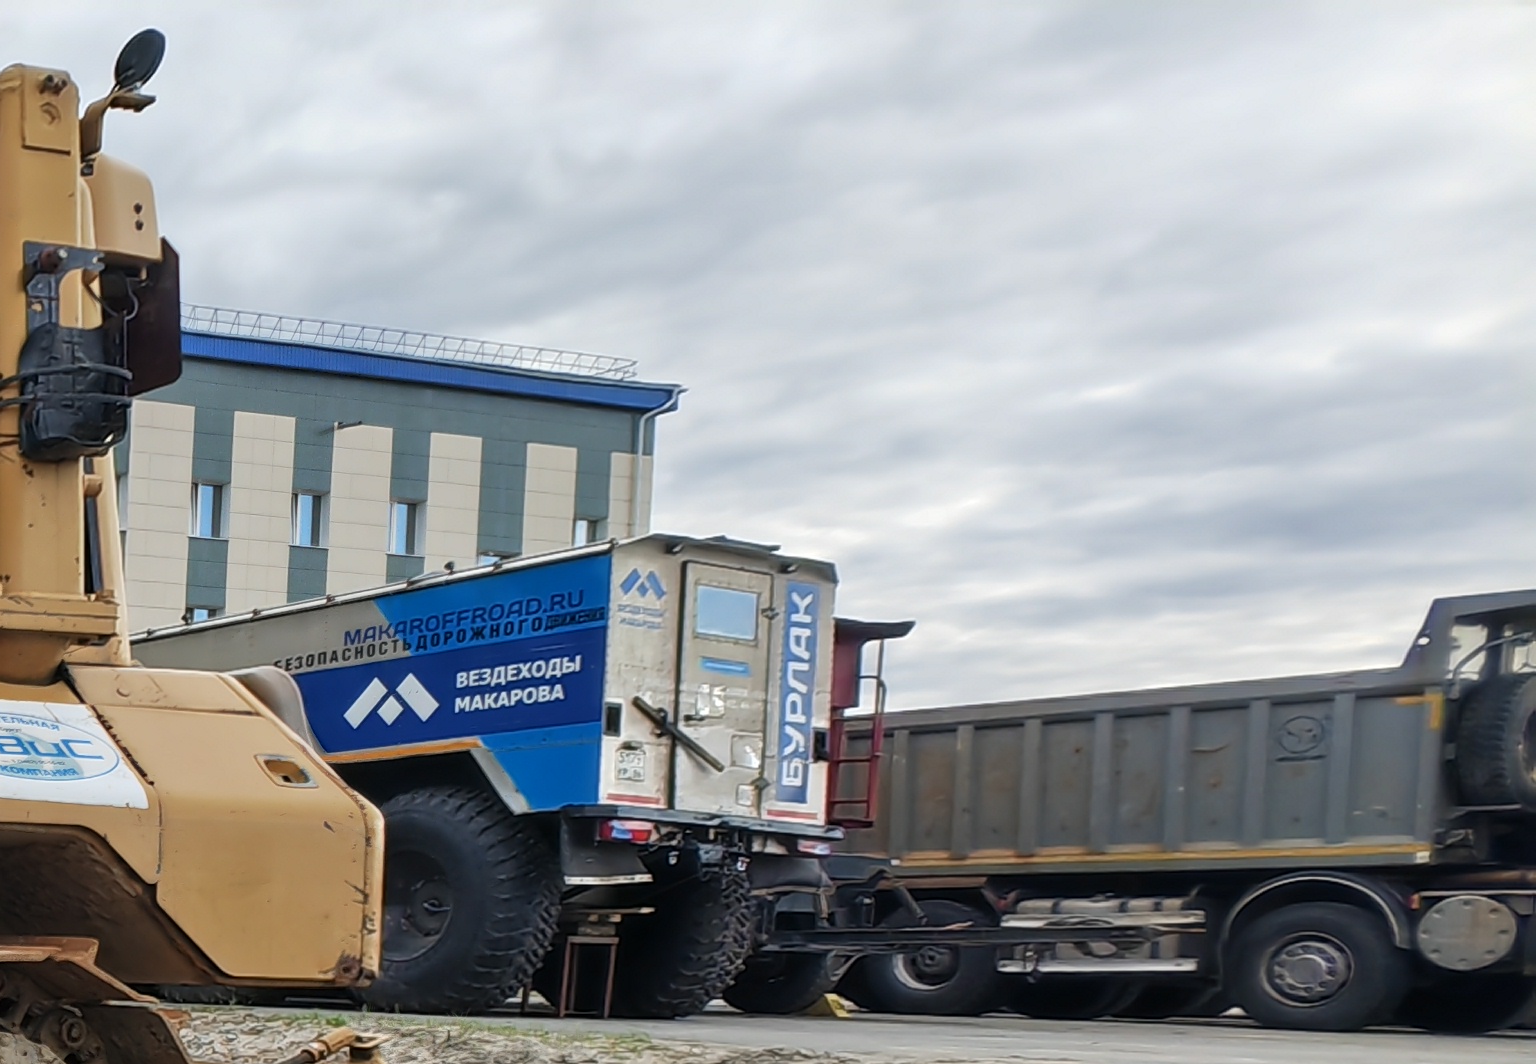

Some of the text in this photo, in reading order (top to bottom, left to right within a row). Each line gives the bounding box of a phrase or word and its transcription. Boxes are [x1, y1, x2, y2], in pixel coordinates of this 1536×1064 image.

[343, 589, 585, 647] MAKAROFFROAD.RU
[415, 616, 543, 652] ДОРОЖНОГО
[455, 654, 582, 689] ВЕЗДЕХОДЫ
[781, 591, 814, 787] БУРЛАК
[454, 684, 565, 714] МАКАРОВА
[0, 764, 80, 777] КОМПАНИЯ
